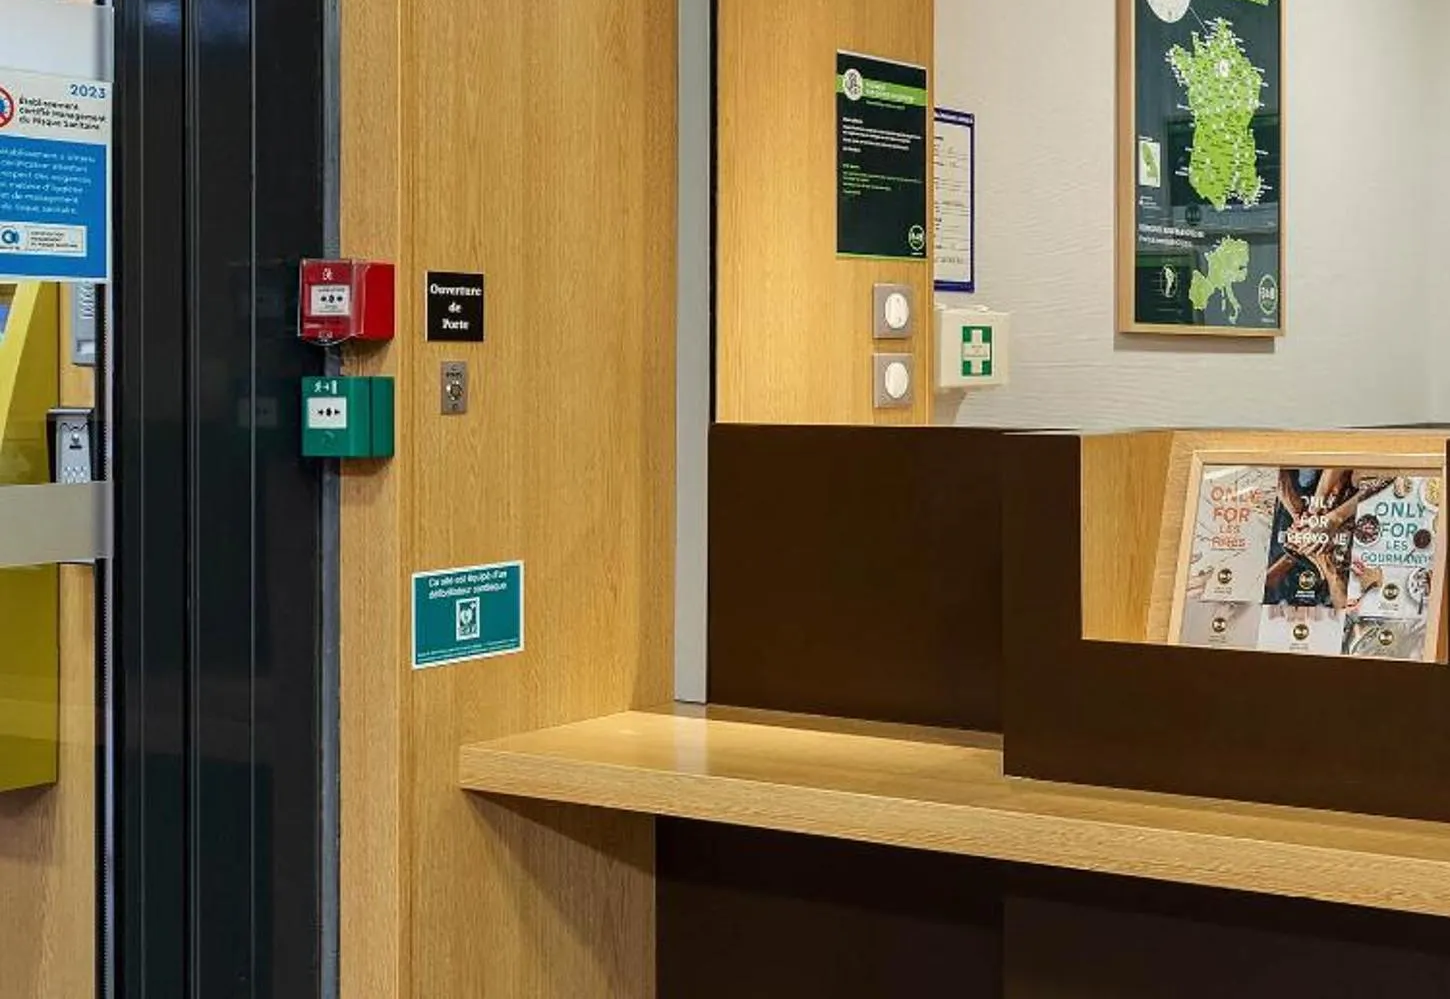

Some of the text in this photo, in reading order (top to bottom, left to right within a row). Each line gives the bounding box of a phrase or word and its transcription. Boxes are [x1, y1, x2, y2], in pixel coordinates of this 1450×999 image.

[70, 84, 106, 99] 2023
[430, 282, 483, 297] Ouverture
[448, 301, 462, 314] de
[442, 318, 469, 331] Porte
[1213, 507, 1251, 522] FOR
[1375, 501, 1426, 518] ONLY
[1301, 515, 1329, 529] FOR
[1386, 540, 1409, 551] LES
